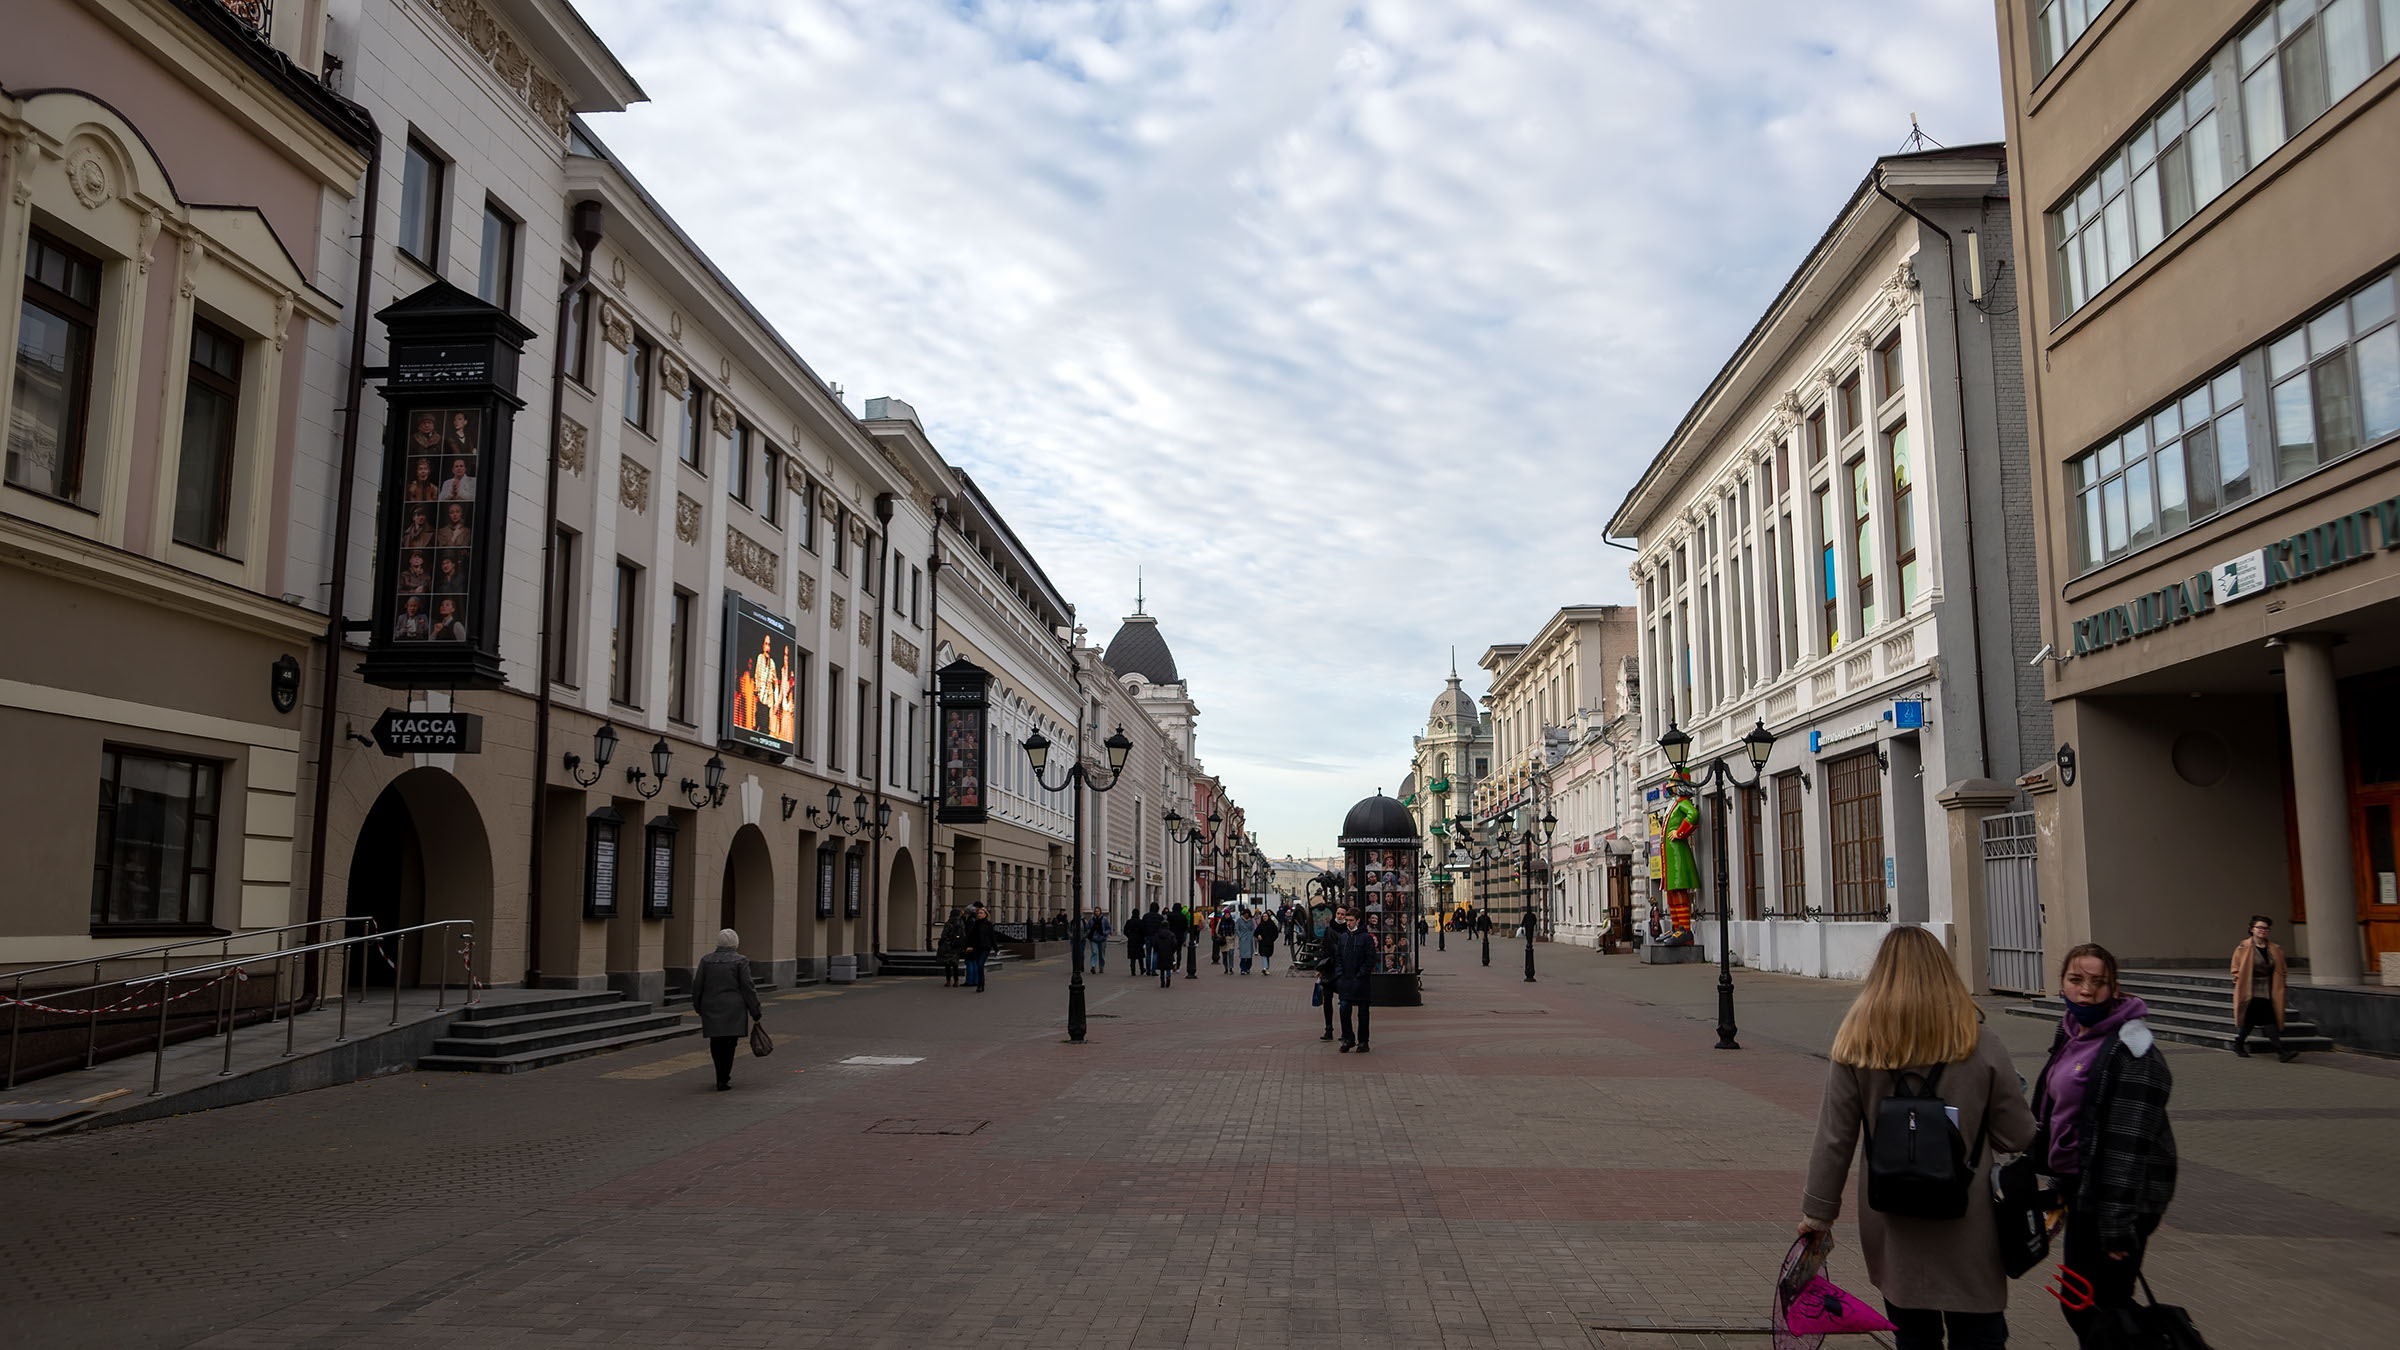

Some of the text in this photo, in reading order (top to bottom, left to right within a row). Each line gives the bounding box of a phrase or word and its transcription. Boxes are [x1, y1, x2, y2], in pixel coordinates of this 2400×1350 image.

[2072, 571, 2213, 655] КИТАПЛАР
[391, 719, 456, 733] КАССА
[391, 734, 456, 744] ТЕАТРА
